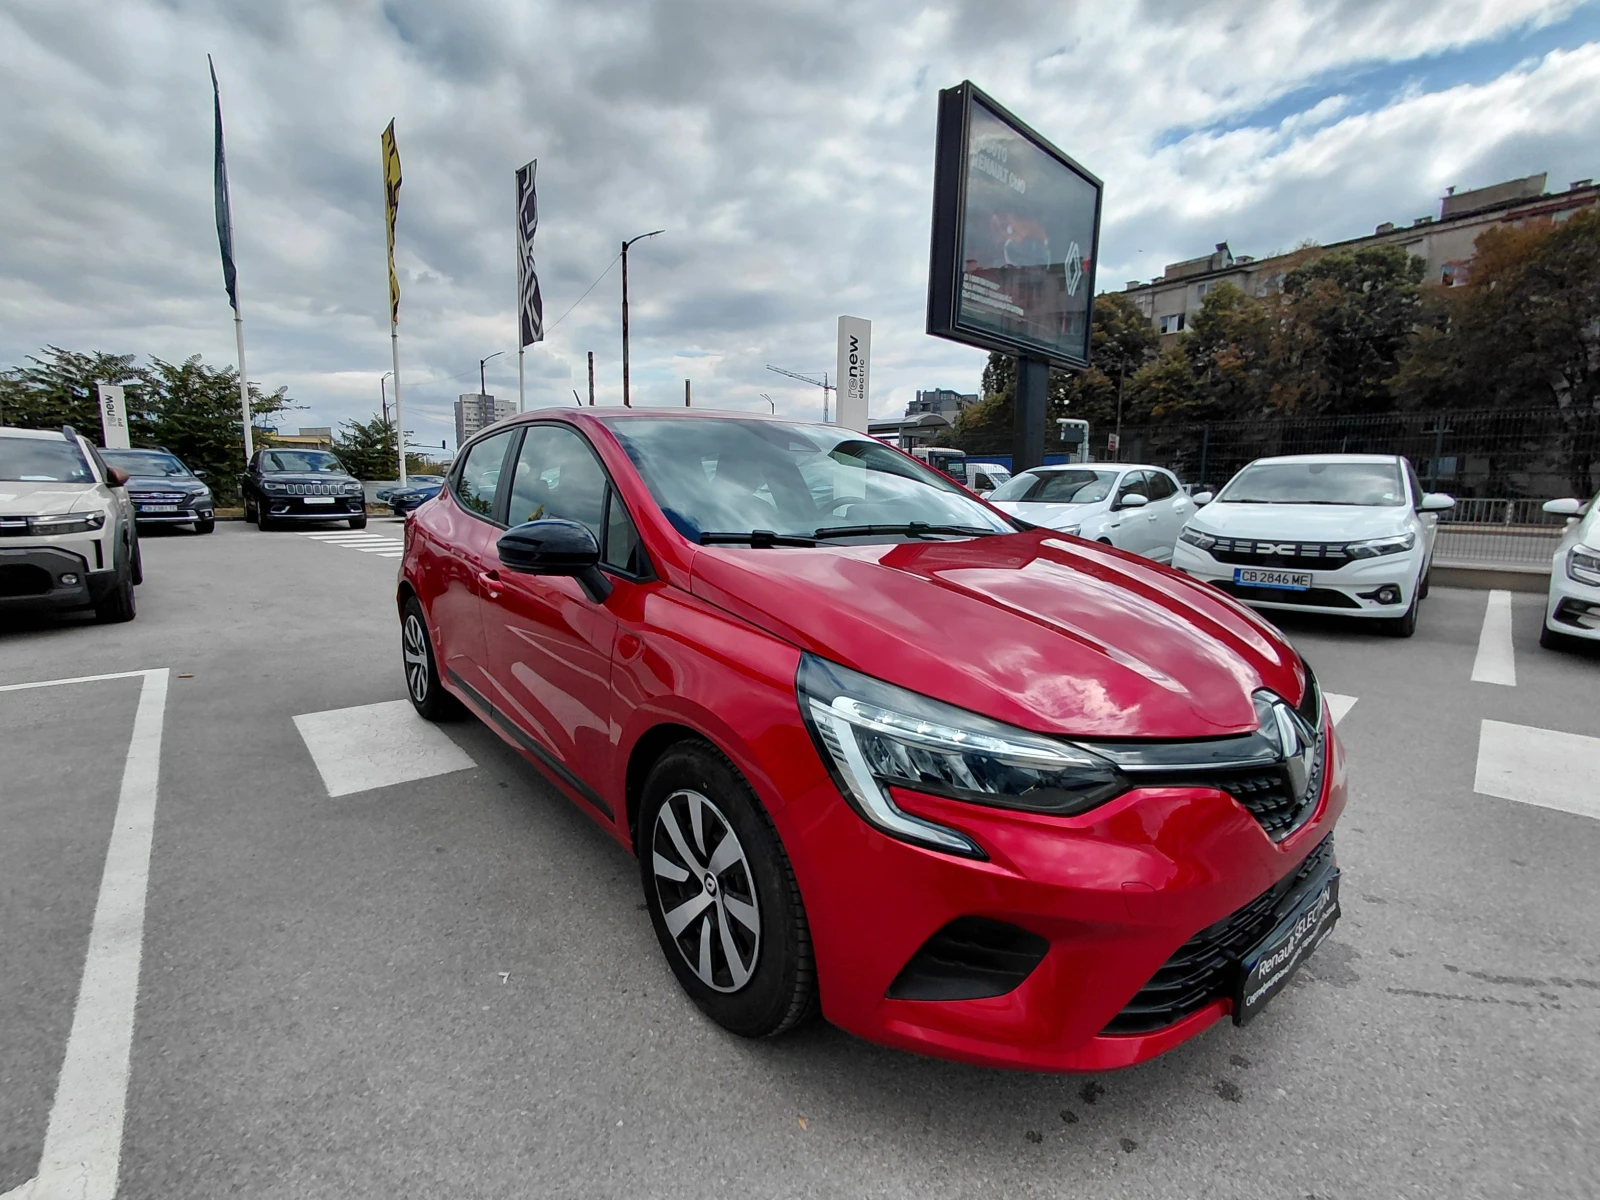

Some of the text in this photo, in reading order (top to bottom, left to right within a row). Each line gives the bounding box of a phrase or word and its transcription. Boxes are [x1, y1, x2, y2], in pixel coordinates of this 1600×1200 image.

[848, 334, 859, 399] renew
[1242, 571, 1309, 586] CB 2846 ME
[1258, 935, 1294, 980] Renault
